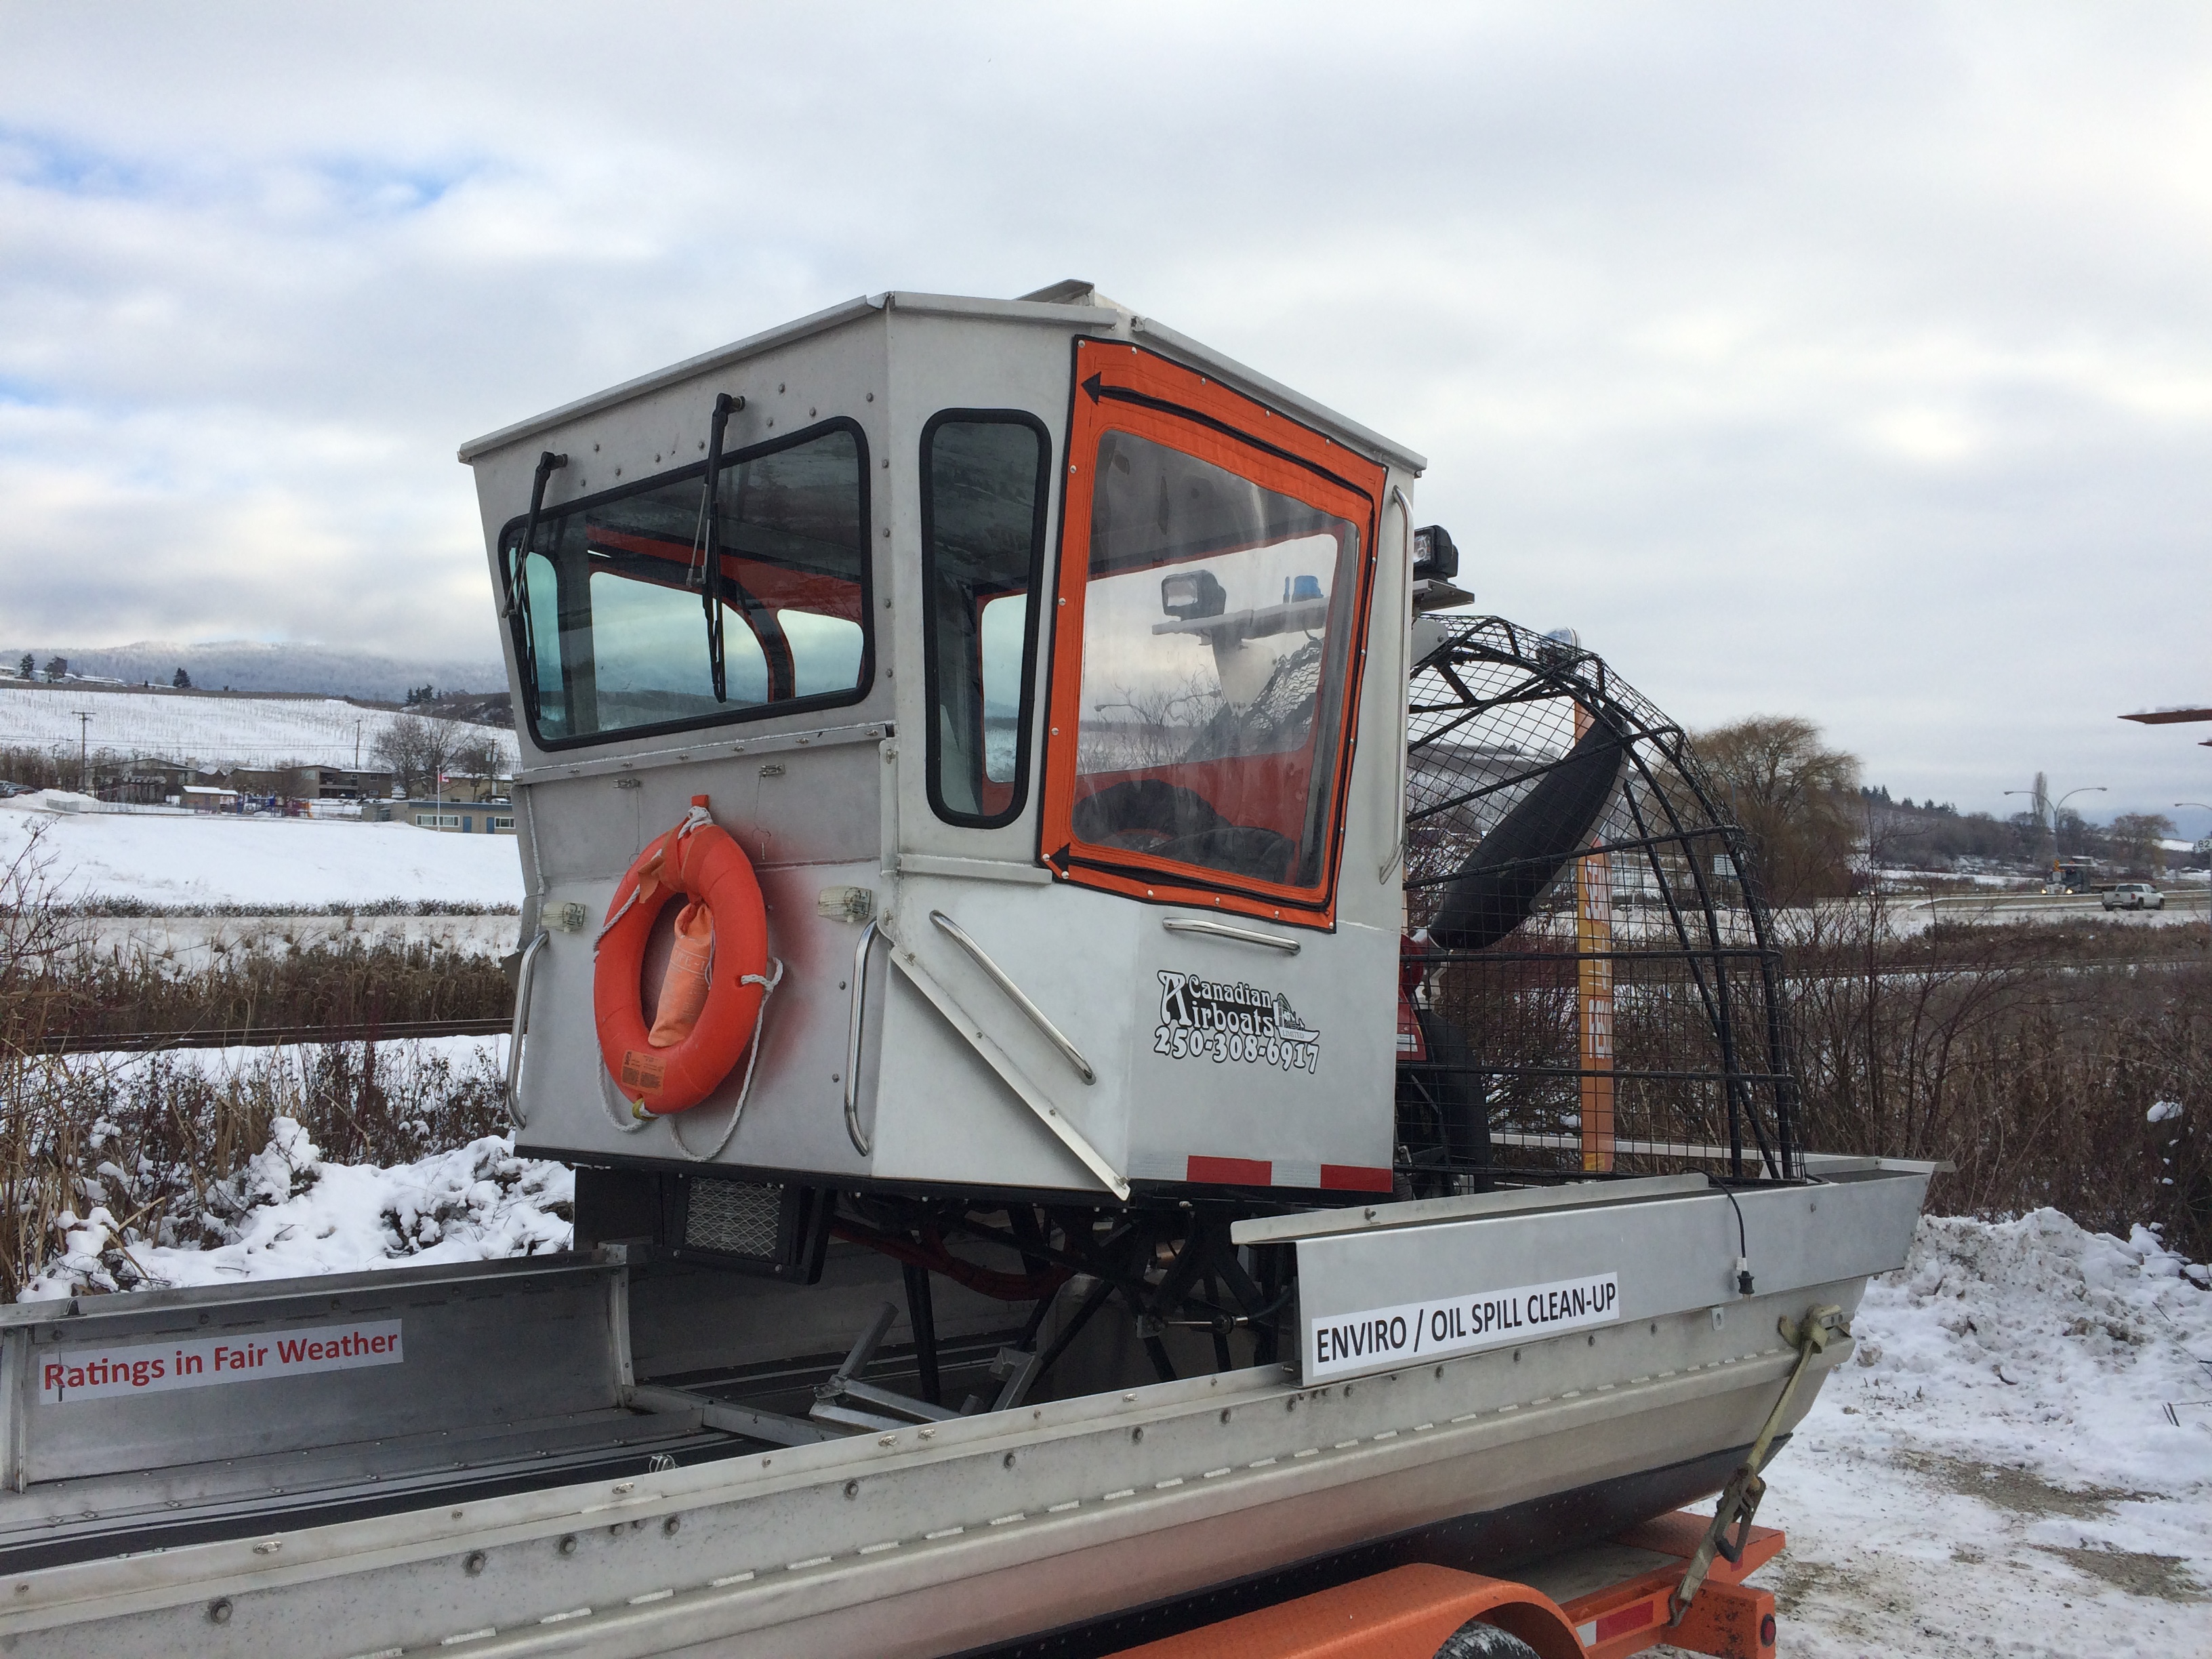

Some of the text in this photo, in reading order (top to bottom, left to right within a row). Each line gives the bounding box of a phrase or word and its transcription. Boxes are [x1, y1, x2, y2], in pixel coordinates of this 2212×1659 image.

[1157, 970, 1275, 1038] Airboats
[1188, 974, 1273, 1008] Canadian
[1153, 1025, 1320, 1075] 250-308-6917
[1282, 1029, 1305, 1039] LIMITED
[1317, 1316, 1407, 1363] ENVIRO
[1431, 1307, 1467, 1342] OIL
[1471, 1298, 1523, 1334] SPILL
[1527, 1282, 1616, 1324] CLEAN-UP
[44, 1331, 398, 1390] Ratings in Fair Weather
